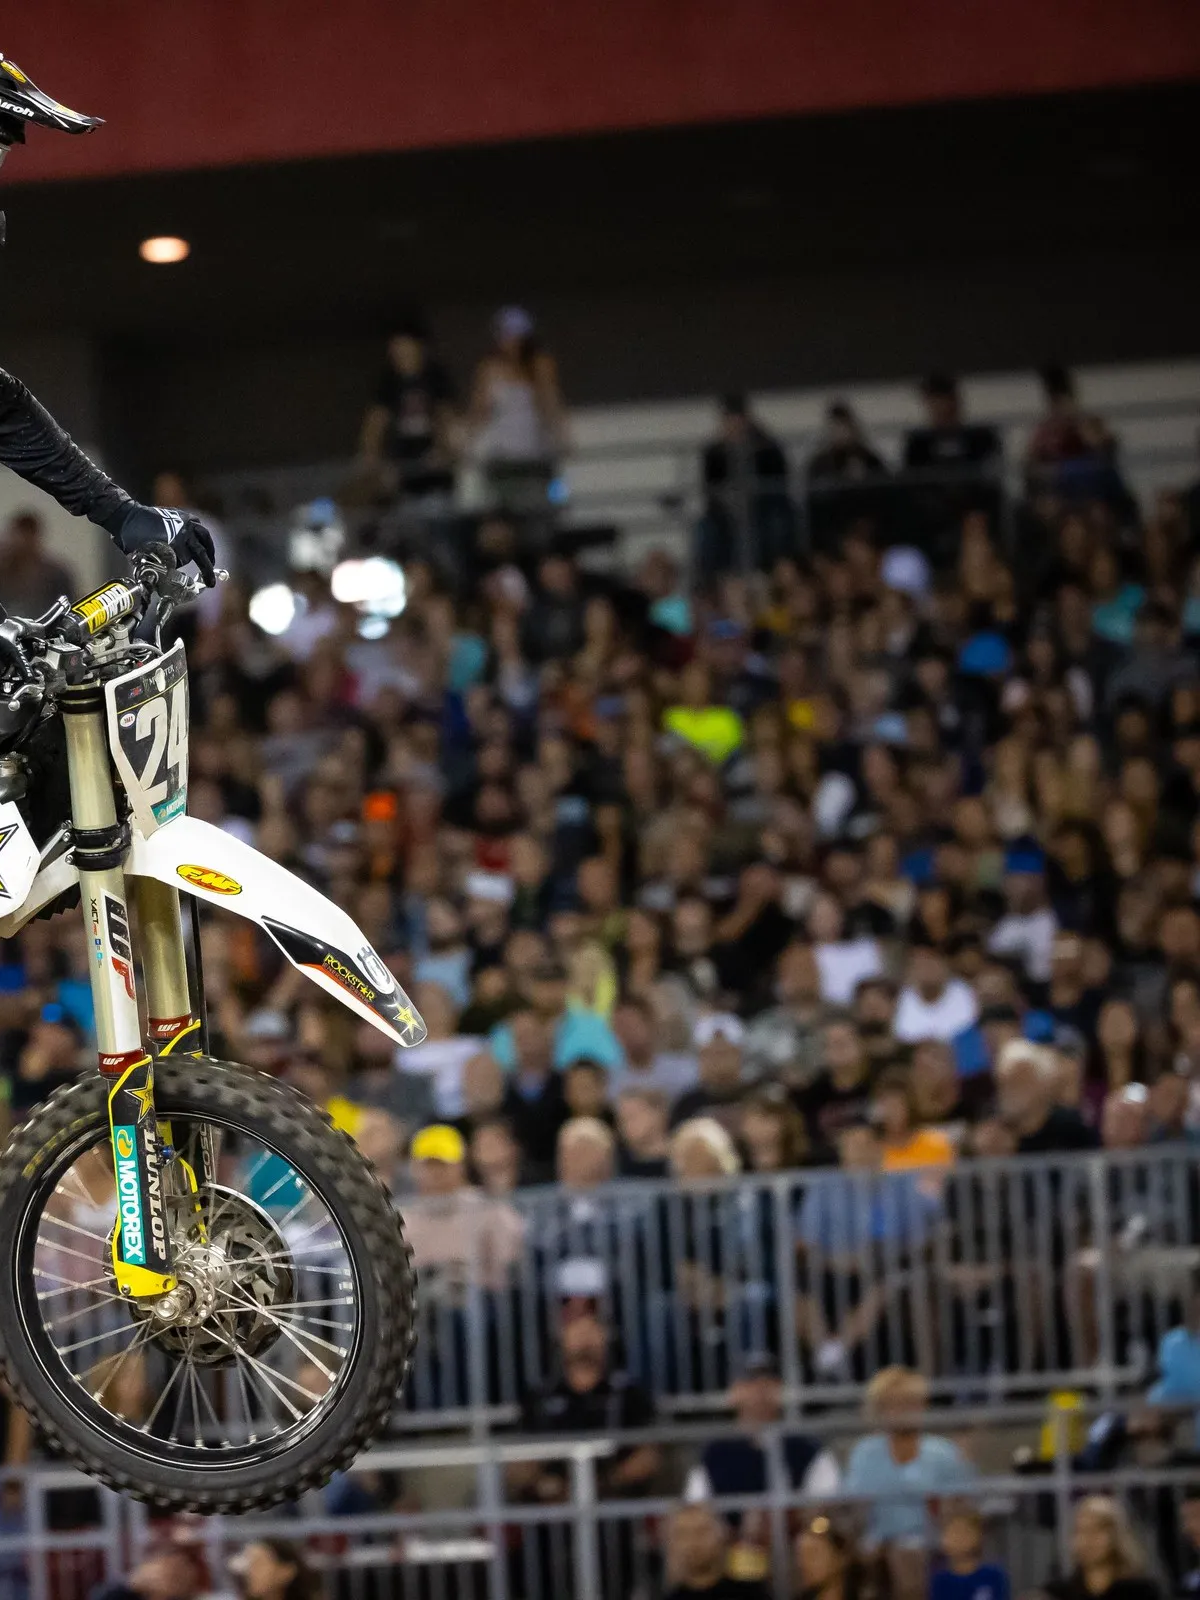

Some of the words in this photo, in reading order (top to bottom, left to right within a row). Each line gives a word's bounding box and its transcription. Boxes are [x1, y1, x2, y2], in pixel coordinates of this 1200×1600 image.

[133, 678, 188, 806] 24
[178, 865, 242, 894] FMF
[90, 898, 99, 924] XACT
[323, 952, 377, 1003] ROCKSTAR
[157, 1022, 181, 1032] WP
[102, 1056, 124, 1066] WP
[118, 1160, 143, 1260] MOTOREX
[143, 1128, 167, 1261] DUNLOP
